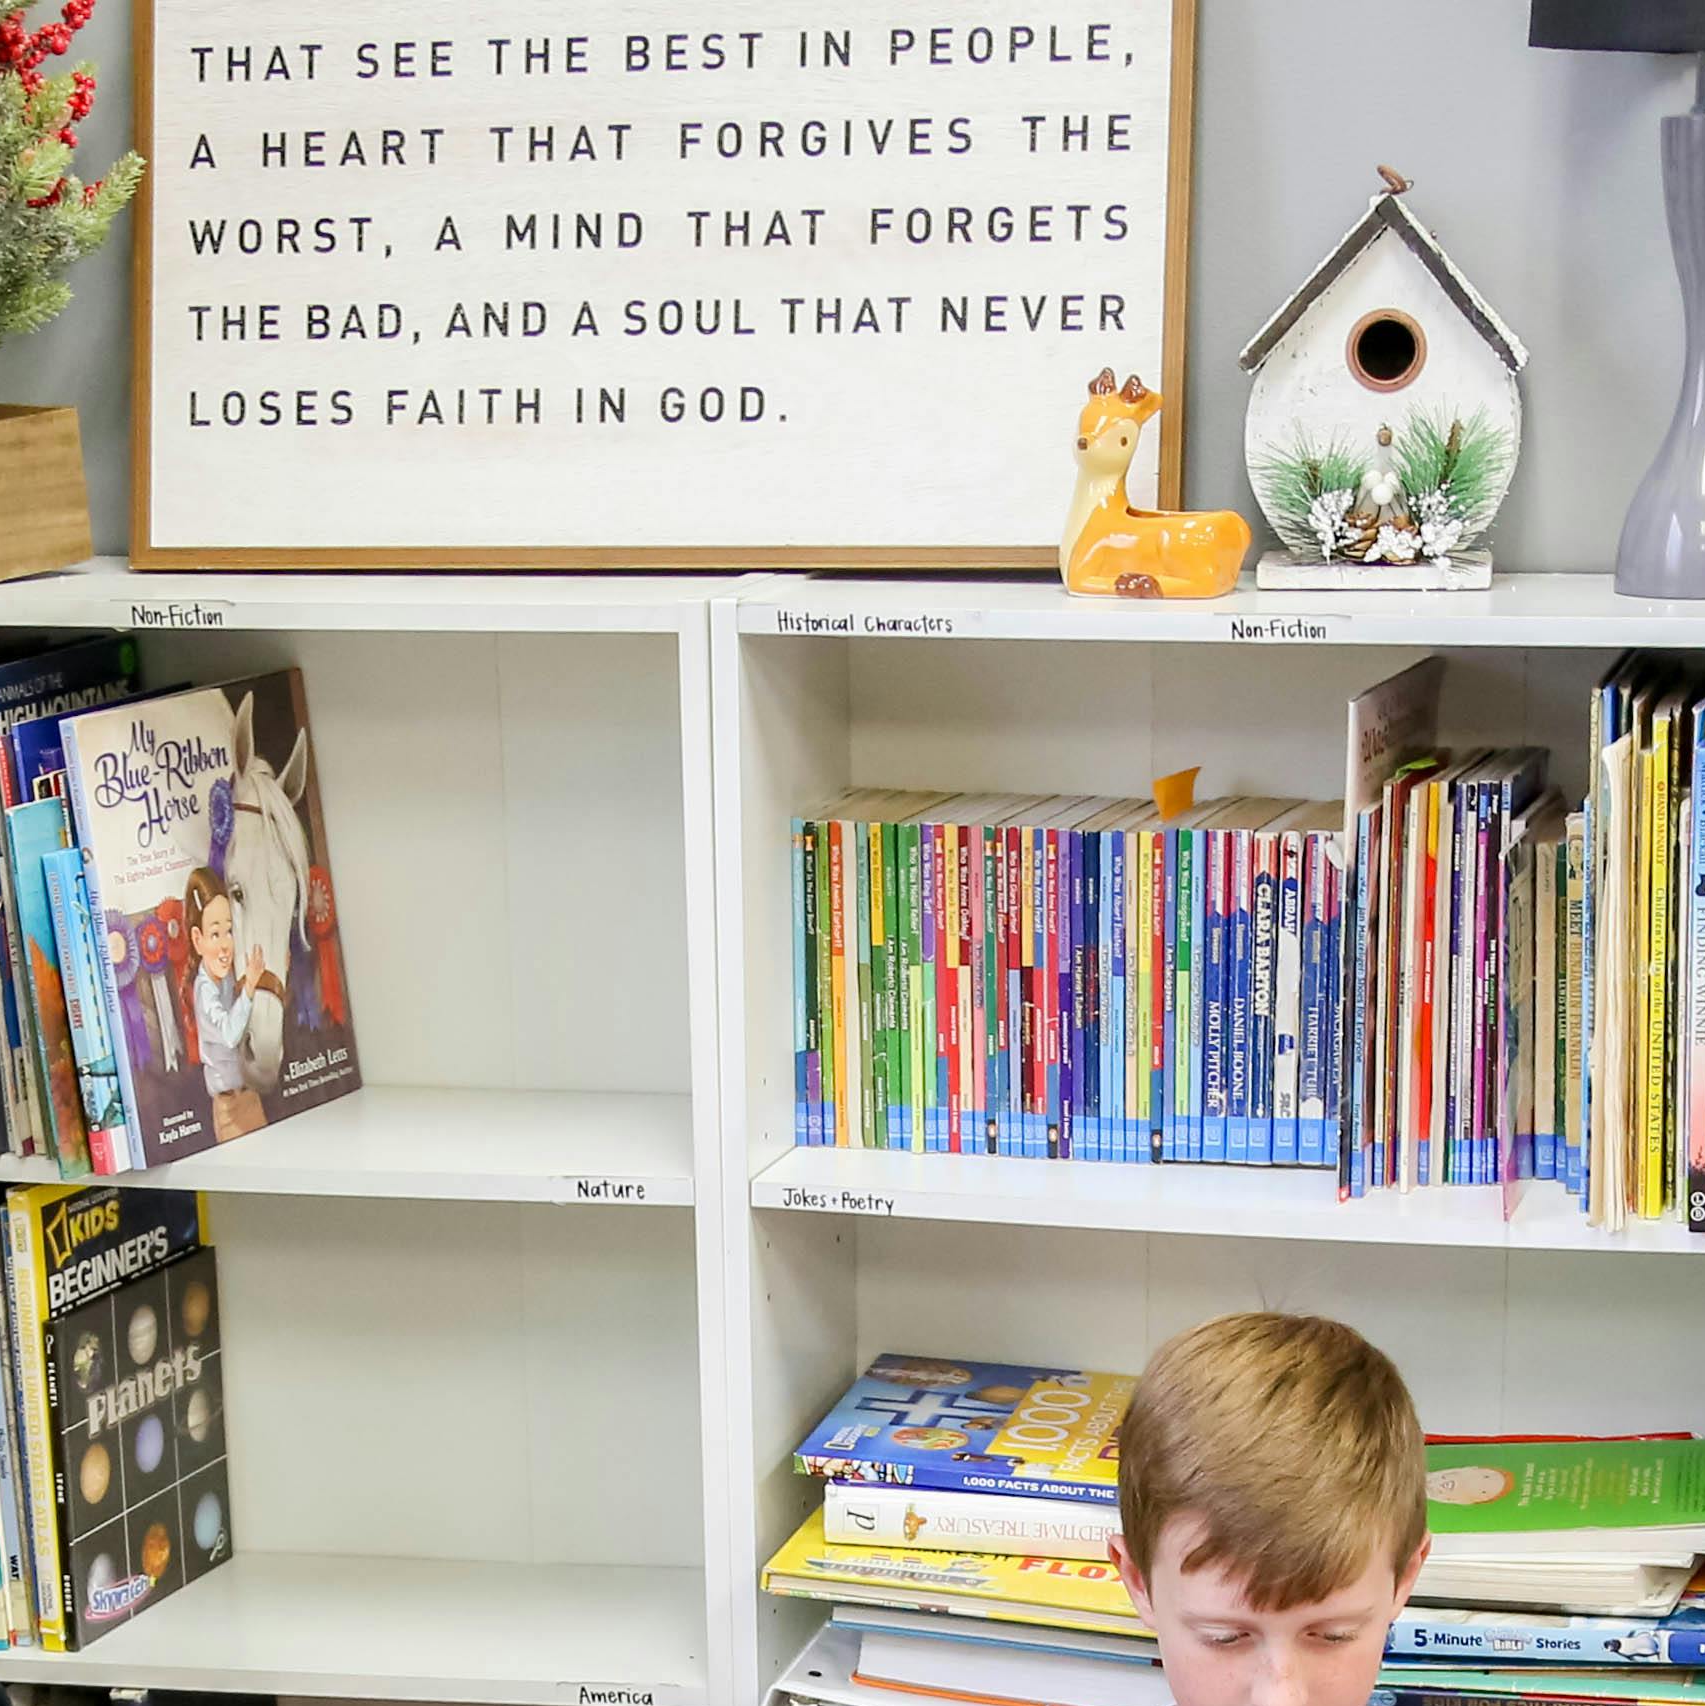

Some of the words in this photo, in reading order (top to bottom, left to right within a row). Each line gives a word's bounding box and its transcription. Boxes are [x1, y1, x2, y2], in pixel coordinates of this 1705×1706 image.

[191, 44, 323, 82] THAT
[356, 41, 453, 79] SEE
[487, 37, 588, 75] THE
[626, 32, 763, 72] BEST
[800, 30, 850, 68] IN
[890, 24, 1133, 67] PEOPLE,
[189, 133, 216, 169] A
[262, 128, 444, 168] HEART
[489, 124, 632, 163] THAT
[680, 117, 972, 159] FORGIVES
[1021, 114, 1131, 152] THE
[189, 217, 392, 258] WORST,
[435, 215, 462, 251] A
[506, 212, 642, 250] MIND
[687, 209, 825, 247] THAT
[870, 204, 1128, 245] FORGETS
[188, 305, 280, 341] THE
[307, 303, 420, 345] BAD,
[445, 301, 547, 338] AND
[572, 301, 599, 337] A
[623, 299, 755, 336] SOUL
[781, 296, 911, 334] THAT
[941, 294, 1125, 332] NEVER
[190, 390, 353, 427] LOSES
[387, 388, 540, 425] FAITH
[576, 387, 625, 424] IN
[660, 386, 787, 423] GOD.
[131, 605, 223, 627] Non-Fiction
[777, 611, 854, 633] Historical
[864, 615, 952, 634] Characters
[1231, 619, 1326, 640] Non-Fiction
[127, 719, 156, 753] My
[94, 736, 231, 809] Blue-Ribbon
[137, 791, 202, 847] Horse
[1114, 896, 1123, 921] Albert
[1255, 883, 1271, 942] CLARA
[1568, 899, 1584, 937] MEET
[1253, 945, 1269, 1017] BARTON
[1207, 1001, 1221, 1043] MOLLY
[1232, 997, 1245, 1046] DANIEL
[1206, 1046, 1220, 1107] PITCHER
[1231, 1051, 1244, 1101] BOONE
[1650, 1020, 1664, 1087] UNITED
[1648, 1092, 1661, 1154] STATES
[577, 1180, 643, 1198] Nature
[783, 1188, 827, 1207] Jokes
[841, 1191, 894, 1215] Poetry
[69, 1199, 120, 1243] KIDS
[45, 1224, 169, 1308] BEGINNER'S
[84, 1341, 204, 1439] Planets
[963, 1477, 996, 1488] 1,000
[998, 1478, 1039, 1492] FACTS
[1040, 1482, 1086, 1496] ABOUT
[1088, 1485, 1115, 1499] THE
[1414, 1629, 1483, 1648] 5-Minute
[1536, 1637, 1582, 1651] Stories
[579, 1686, 653, 1706] America
